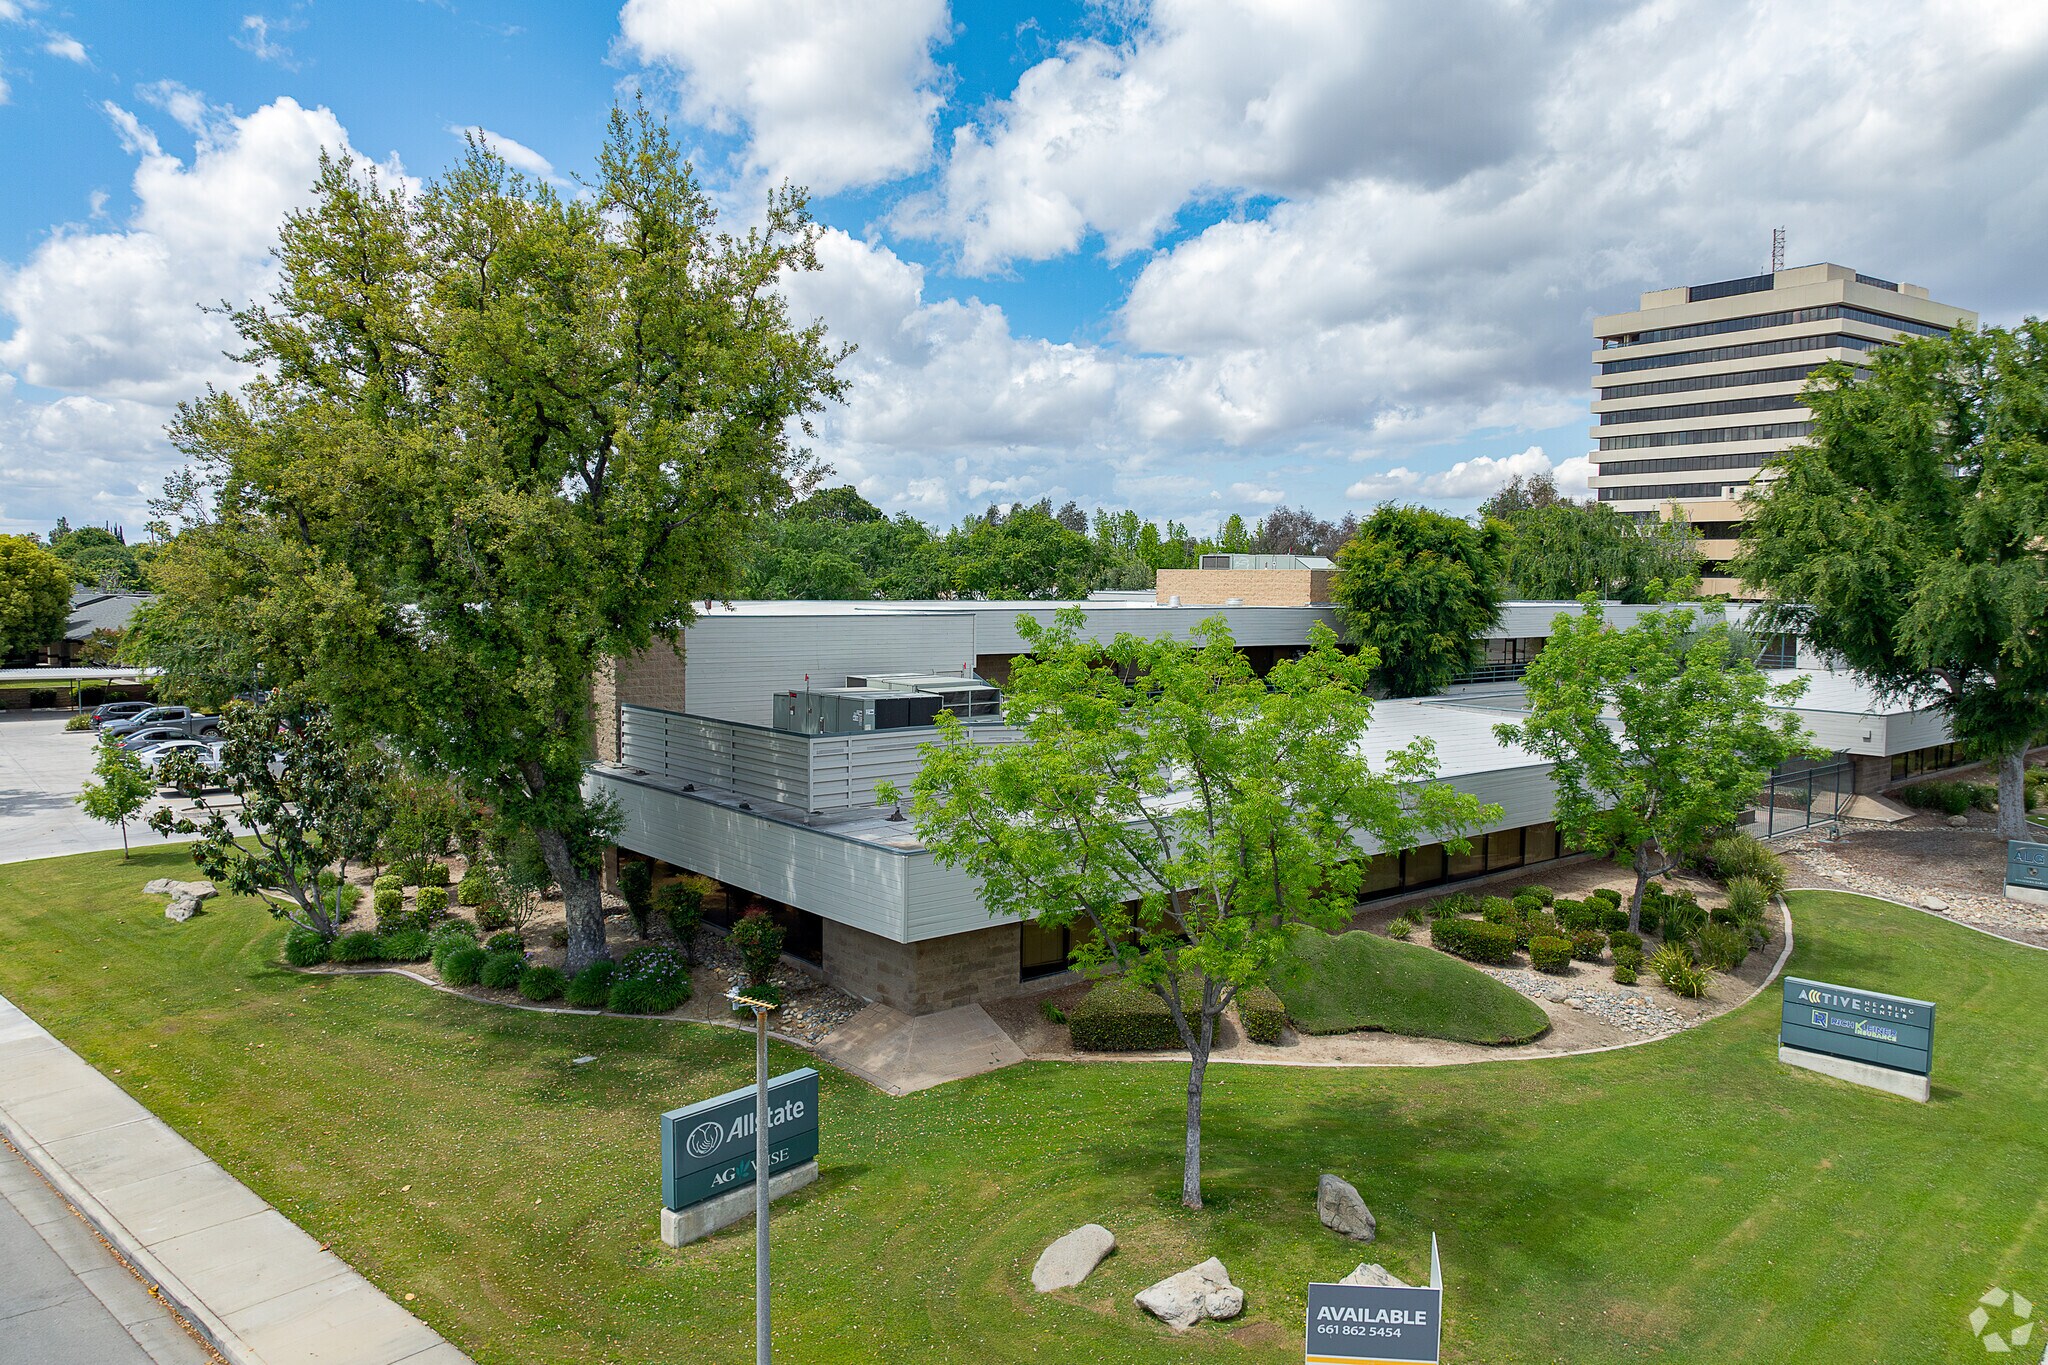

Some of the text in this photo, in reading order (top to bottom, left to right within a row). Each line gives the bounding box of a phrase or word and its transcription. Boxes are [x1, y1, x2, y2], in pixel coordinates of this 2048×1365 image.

[1864, 1000, 1915, 1015] HEARING
[1864, 1007, 1908, 1020] CENTER
[726, 1100, 804, 1143] Alltate
[711, 1167, 736, 1188] AG
[1317, 1306, 1427, 1326] AVAILABLE
[1317, 1324, 1402, 1338] 661 862 5454
